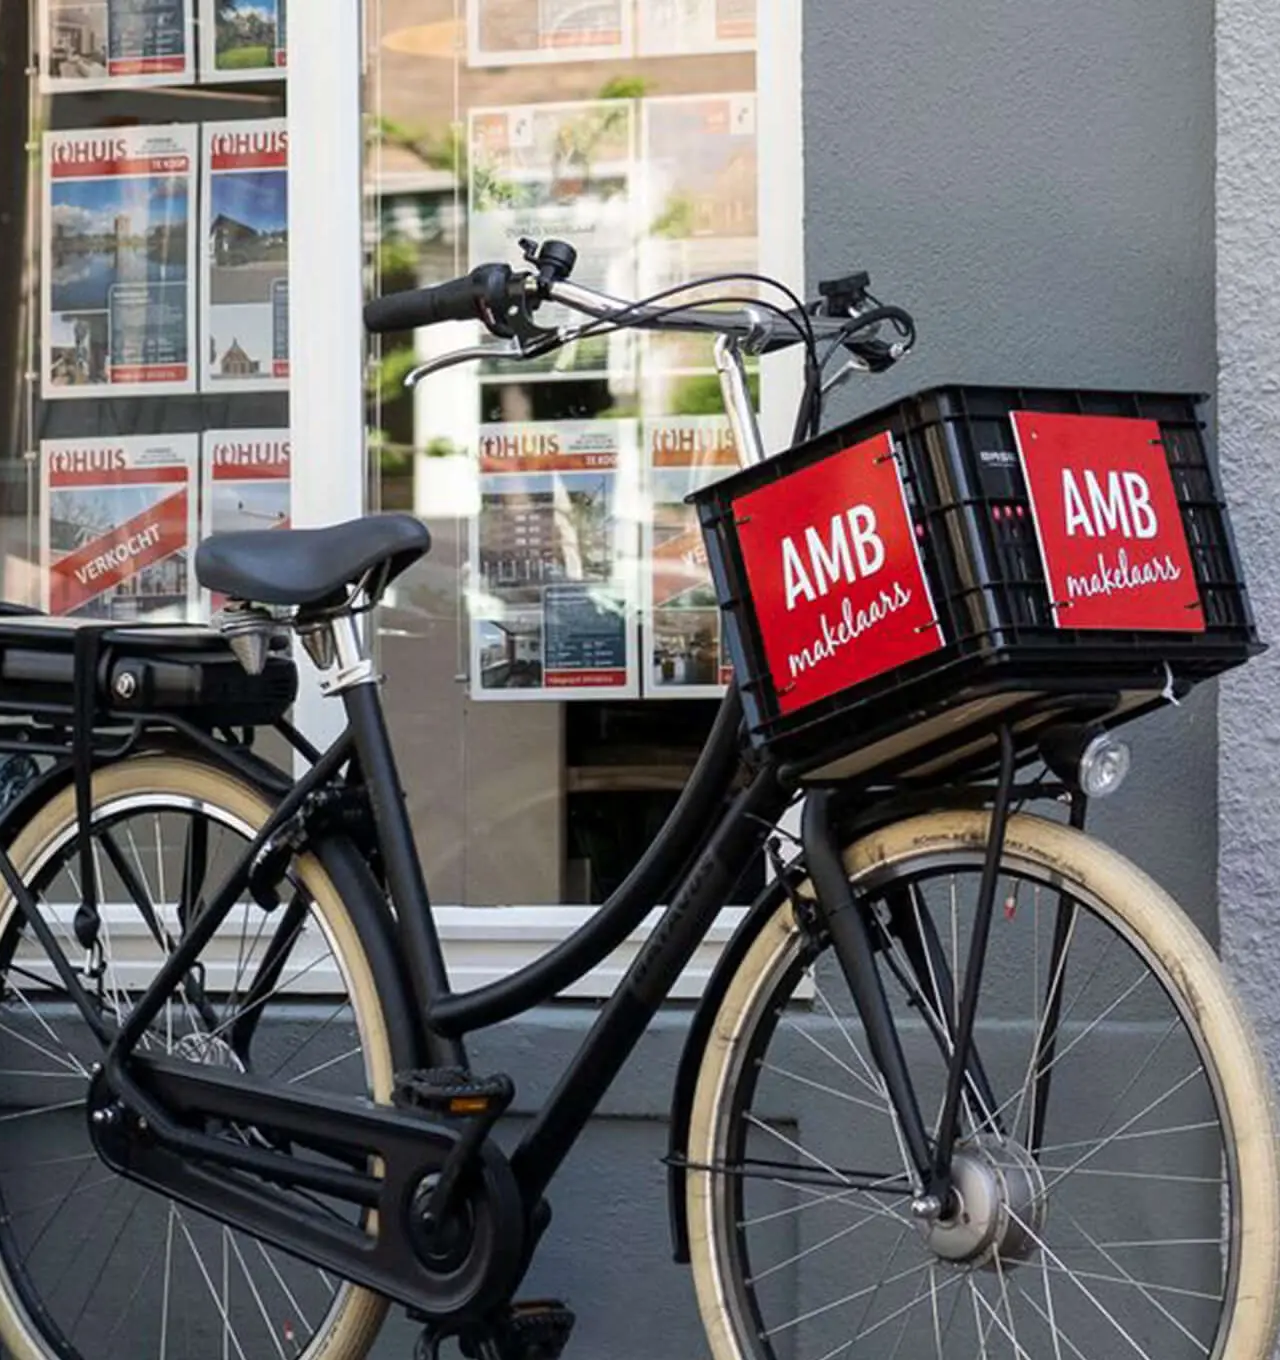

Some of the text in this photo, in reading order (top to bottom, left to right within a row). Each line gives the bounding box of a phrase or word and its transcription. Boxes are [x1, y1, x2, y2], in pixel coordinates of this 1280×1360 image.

[1062, 467, 1158, 539] AMB
[73, 522, 161, 585] VERKOCHT
[781, 503, 886, 612] AMB
[1066, 547, 1182, 598] makelaars
[787, 581, 913, 678] makelaars
